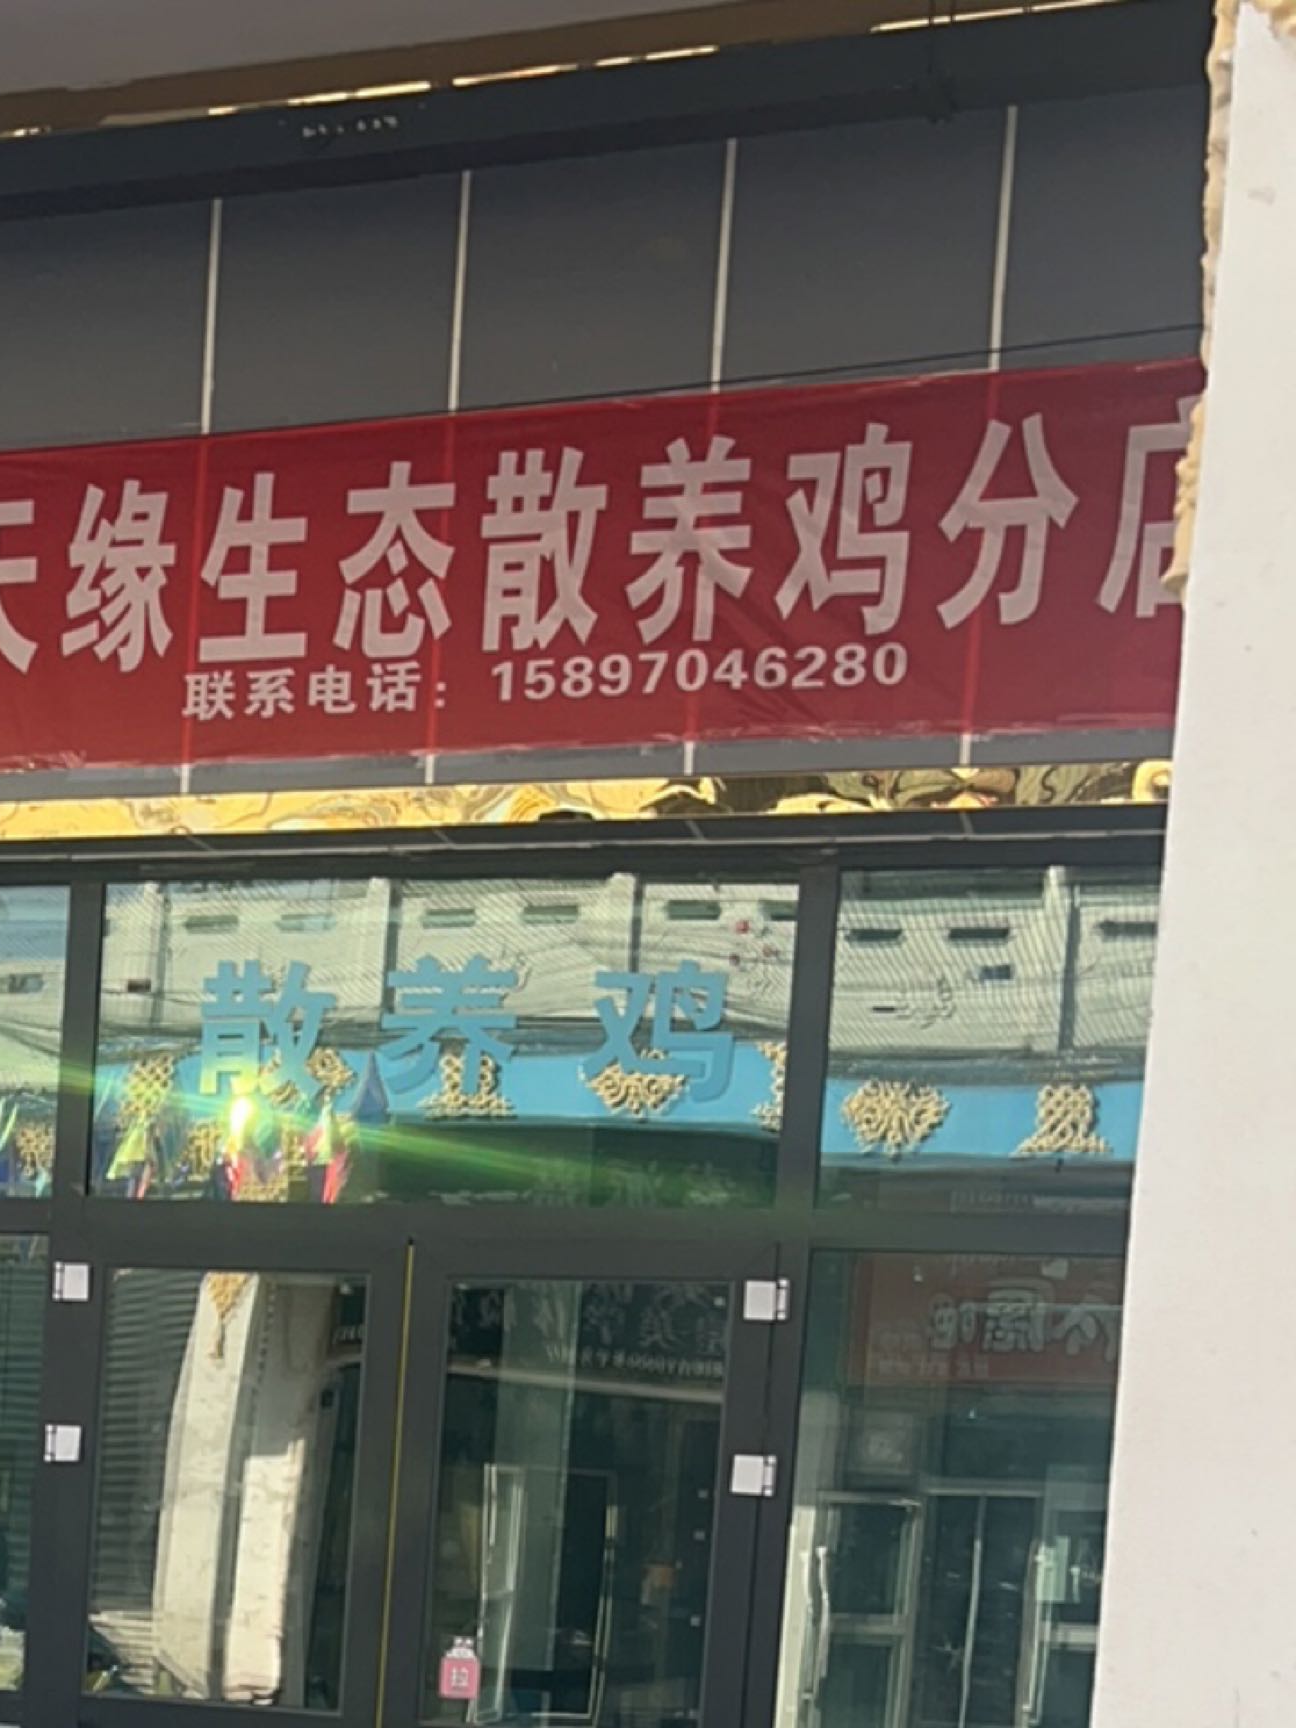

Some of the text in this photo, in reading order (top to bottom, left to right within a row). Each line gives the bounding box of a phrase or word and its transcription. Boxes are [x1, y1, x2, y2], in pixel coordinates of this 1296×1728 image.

[491, 640, 907, 702] 15897046280
[200, 954, 734, 1104] 散养鸡
